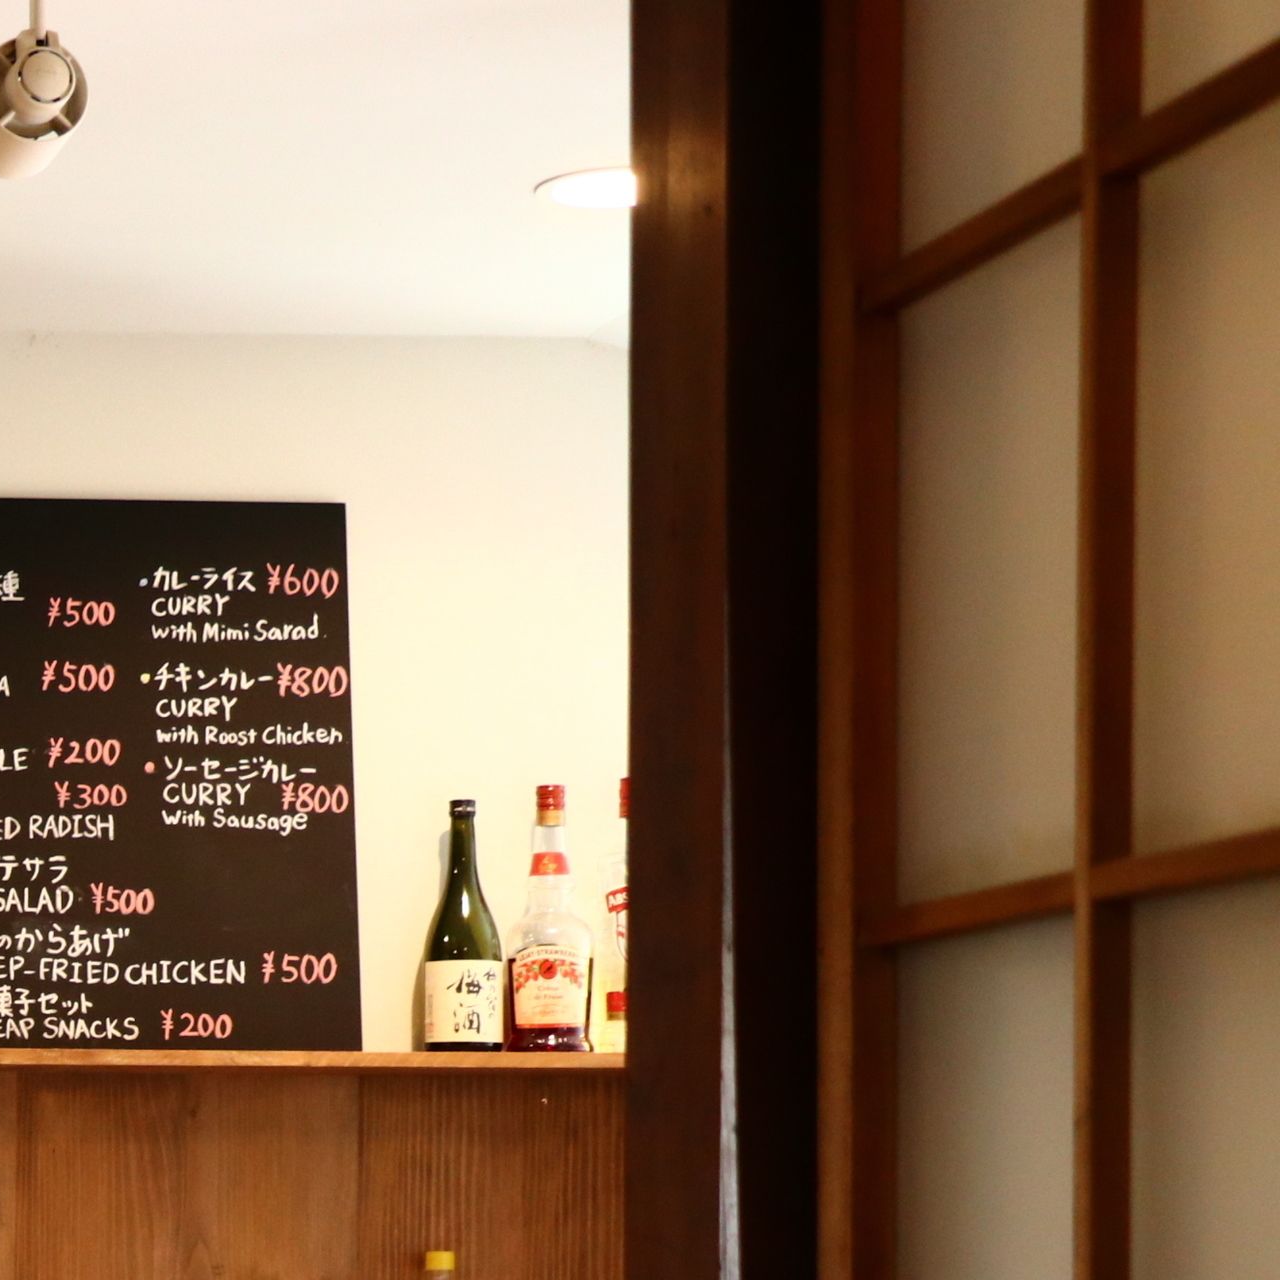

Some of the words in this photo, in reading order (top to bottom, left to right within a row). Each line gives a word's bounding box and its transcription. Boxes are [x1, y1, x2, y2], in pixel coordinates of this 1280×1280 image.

[152, 566, 257, 593] カレーライス
[266, 562, 340, 600] ¥600
[47, 597, 116, 628] ¥500
[150, 592, 231, 617] CURRY
[41, 659, 116, 693] ¥500
[153, 661, 274, 693] チキンカレー
[276, 662, 350, 698] ¥800
[155, 694, 238, 722] CURRY
[261, 721, 344, 746] Chicken
[47, 736, 122, 769] ¥200
[163, 755, 317, 785] ソーセージカレー
[53, 780, 128, 810] ¥300
[162, 781, 252, 807] CURRY
[280, 781, 350, 815] ¥800
[28, 813, 115, 841] RADISH
[213, 807, 309, 836] Sausage
[89, 881, 156, 916] ¥500
[123, 957, 247, 986] CHICKEN
[261, 950, 339, 985] ¥500
[159, 1007, 234, 1041] ¥200
